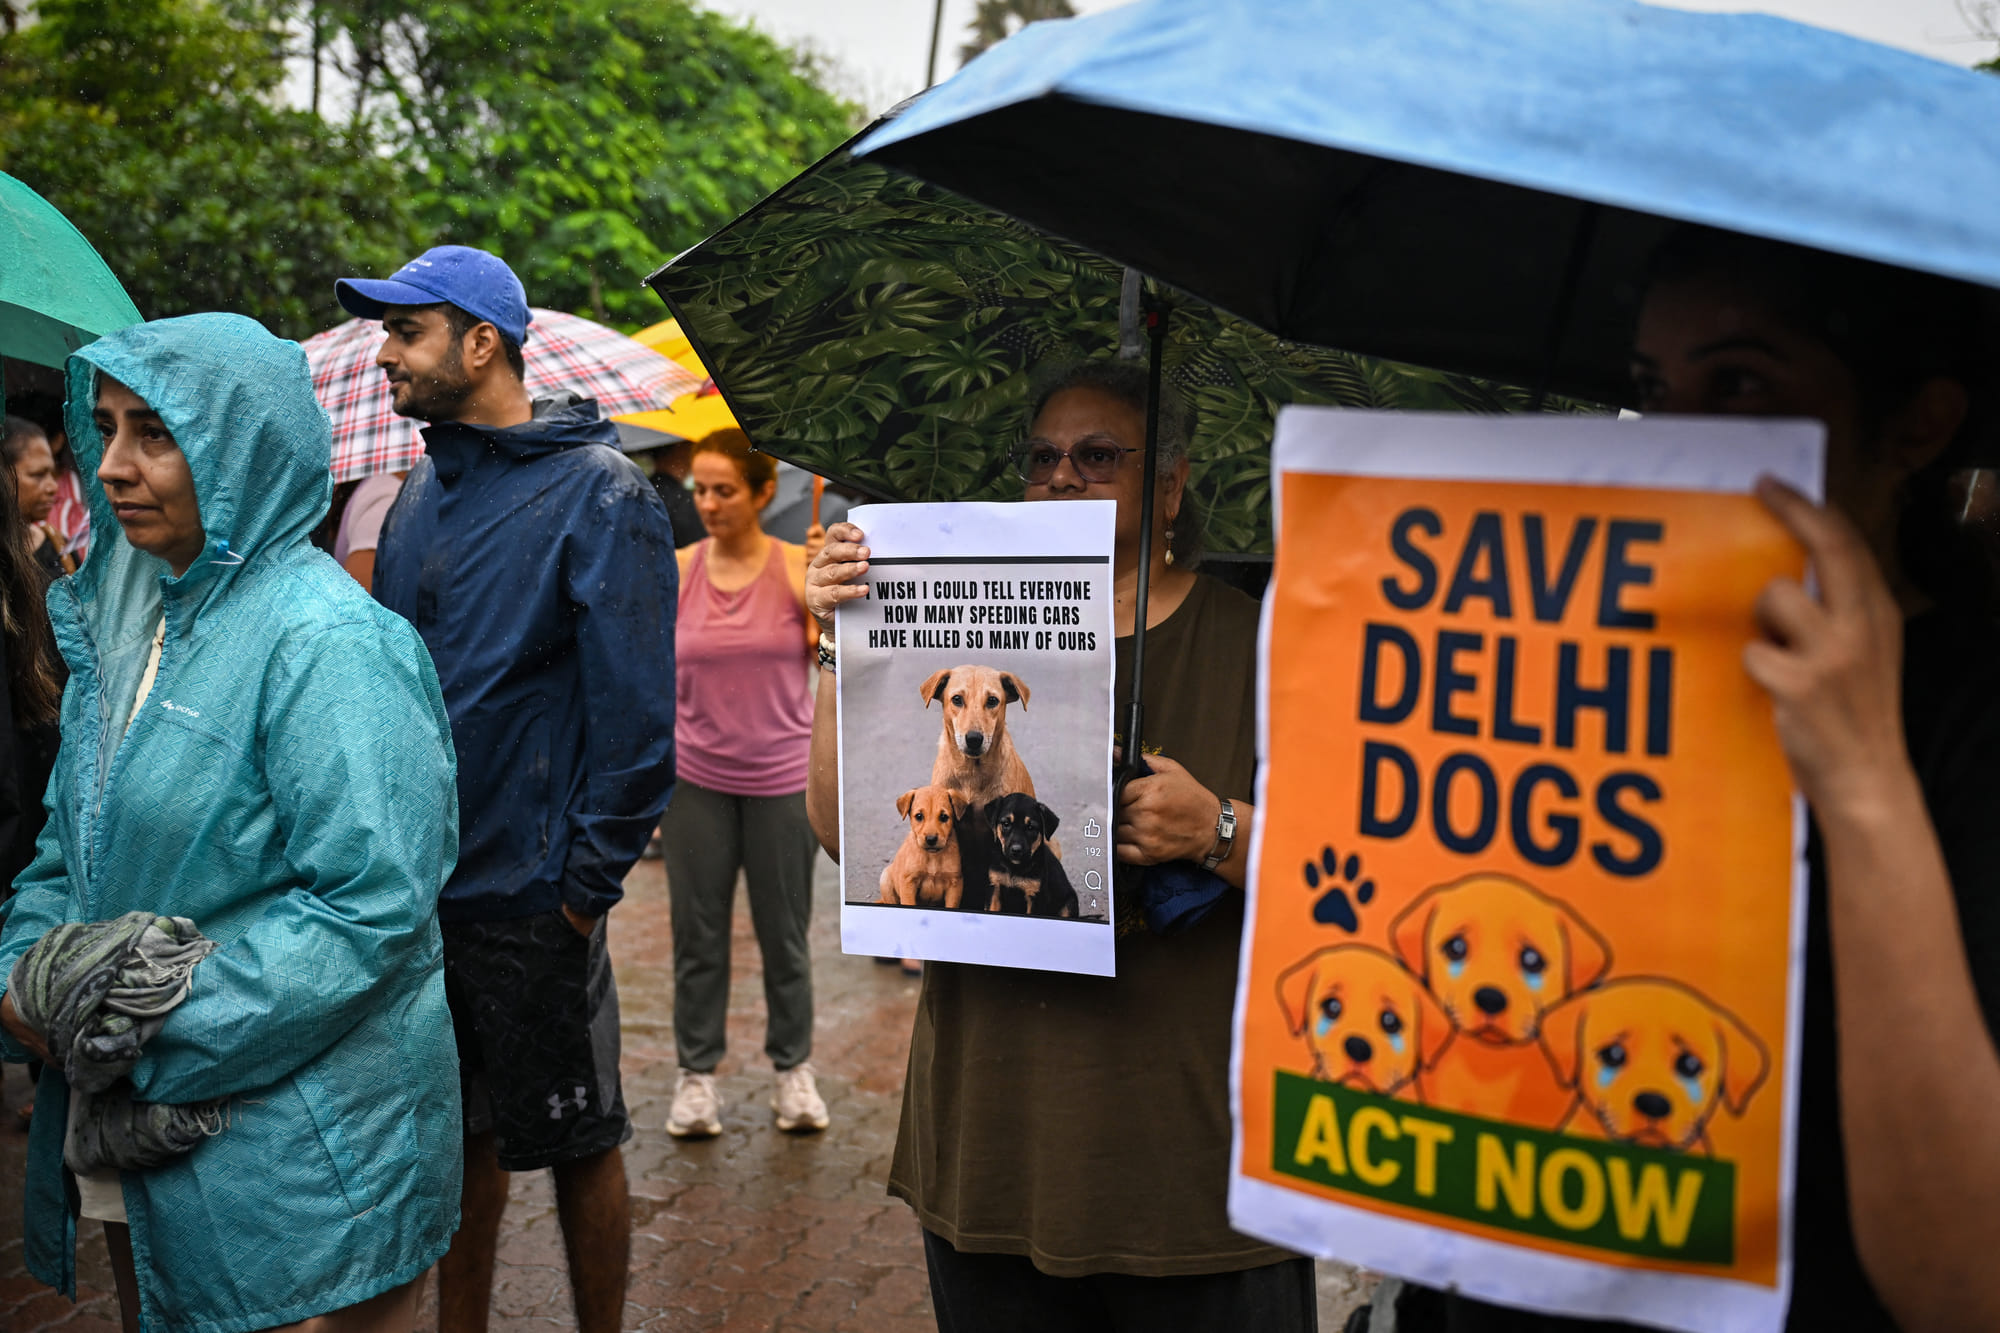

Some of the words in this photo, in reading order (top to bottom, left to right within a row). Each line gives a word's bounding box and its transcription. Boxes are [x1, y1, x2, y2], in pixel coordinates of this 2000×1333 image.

[1380, 506, 1665, 632] SAVE
[876, 581, 916, 600] WISH
[923, 581, 927, 599] I
[934, 581, 977, 600] COULD
[983, 581, 1014, 600] TELL
[1020, 581, 1091, 600] EVERYONE
[884, 605, 918, 624] HOW
[924, 605, 964, 624] MANY
[970, 605, 1037, 625] SPEEDING
[1043, 606, 1080, 625] CARS
[868, 629, 907, 648] HAVE
[913, 630, 960, 649] KILLED
[966, 630, 983, 649] SO
[989, 630, 1029, 650] MANY
[1035, 631, 1052, 650] OF
[1058, 631, 1096, 651] OURS
[1358, 621, 1675, 758] DELHI
[1358, 739, 1665, 879] DOGS
[1085, 847, 1101, 857] 192
[1091, 899, 1097, 908] 4
[1294, 1094, 1454, 1196] ACT
[1476, 1133, 1703, 1247] NOW
